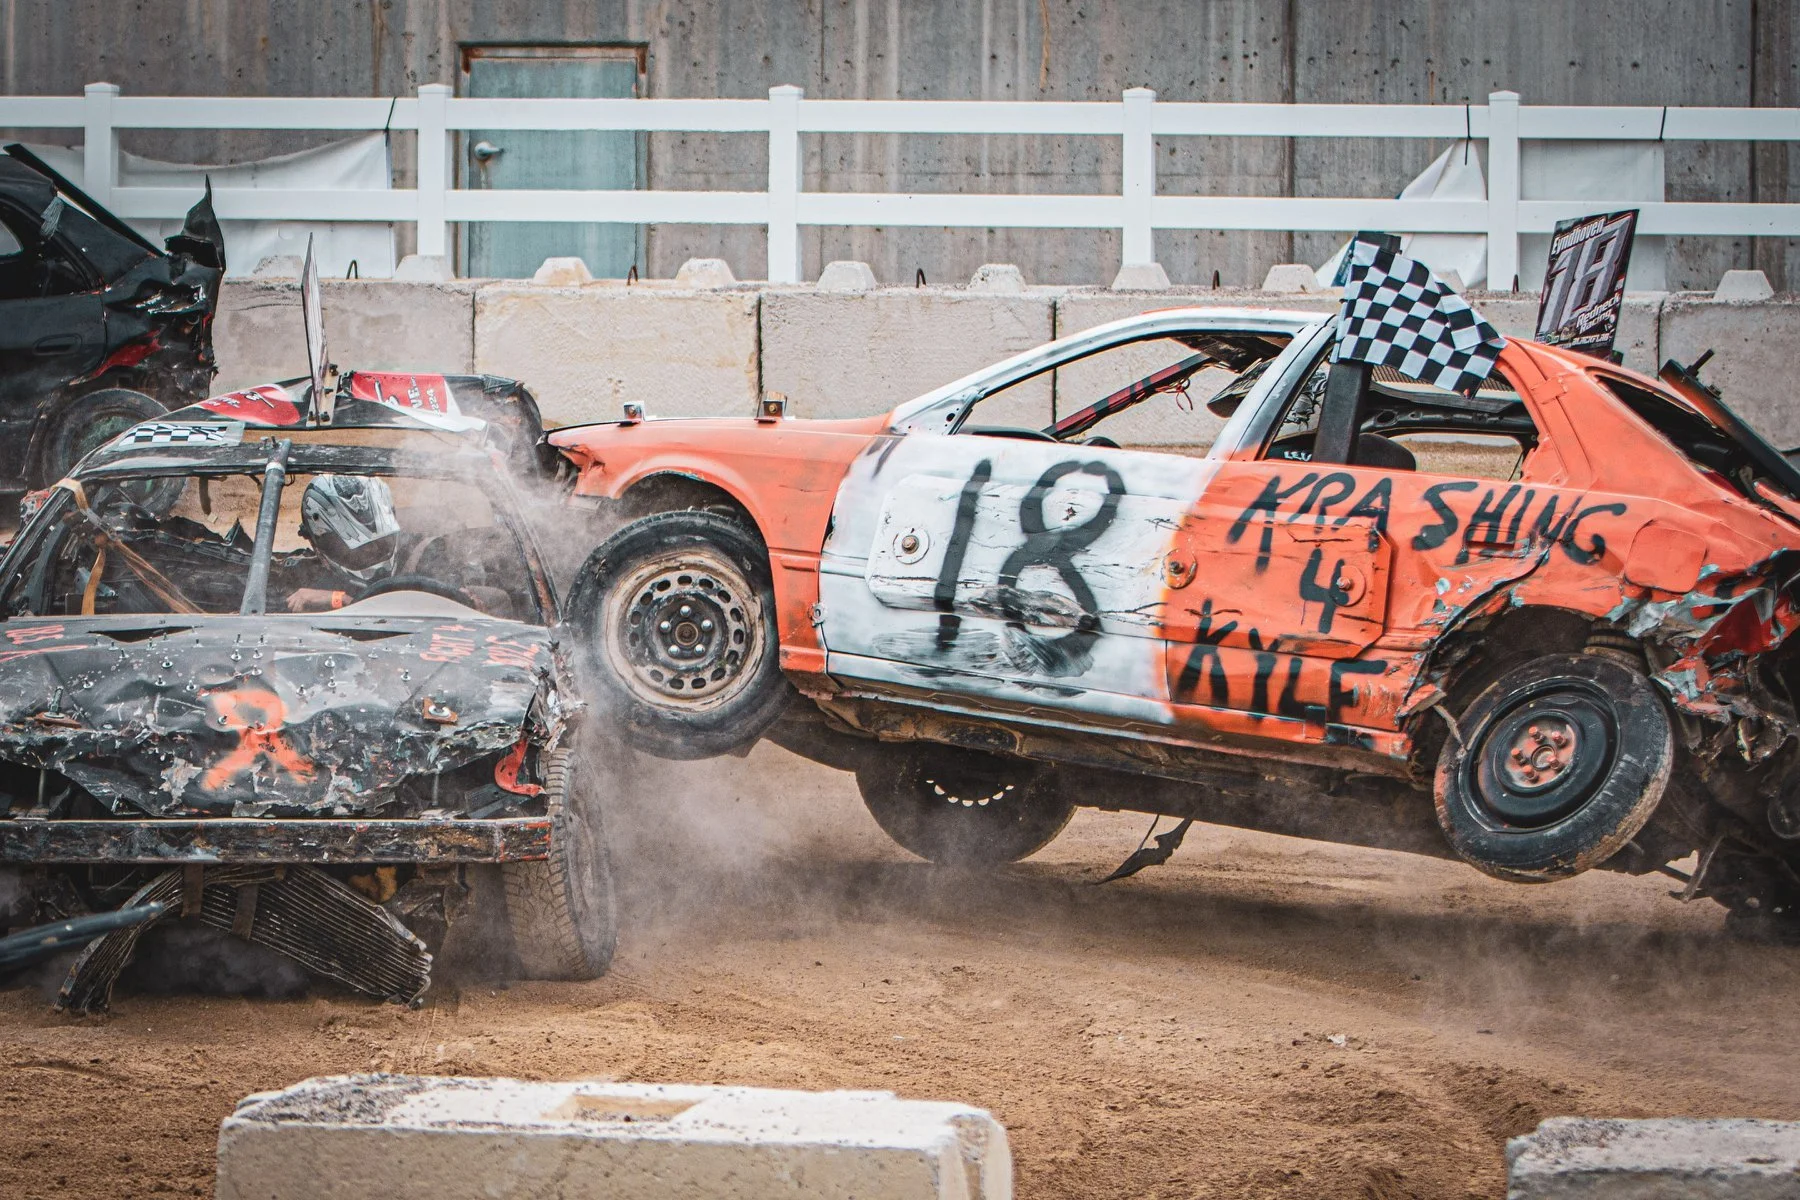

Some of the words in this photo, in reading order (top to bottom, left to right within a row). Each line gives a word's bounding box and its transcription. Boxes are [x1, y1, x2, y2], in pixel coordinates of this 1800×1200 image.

[1539, 213, 1633, 336] 18
[1576, 292, 1621, 329] Redneck
[1579, 308, 1613, 336] Racing
[932, 457, 1127, 678] 18
[1299, 547, 1350, 635] 4
[1175, 597, 1389, 746] KYLE
